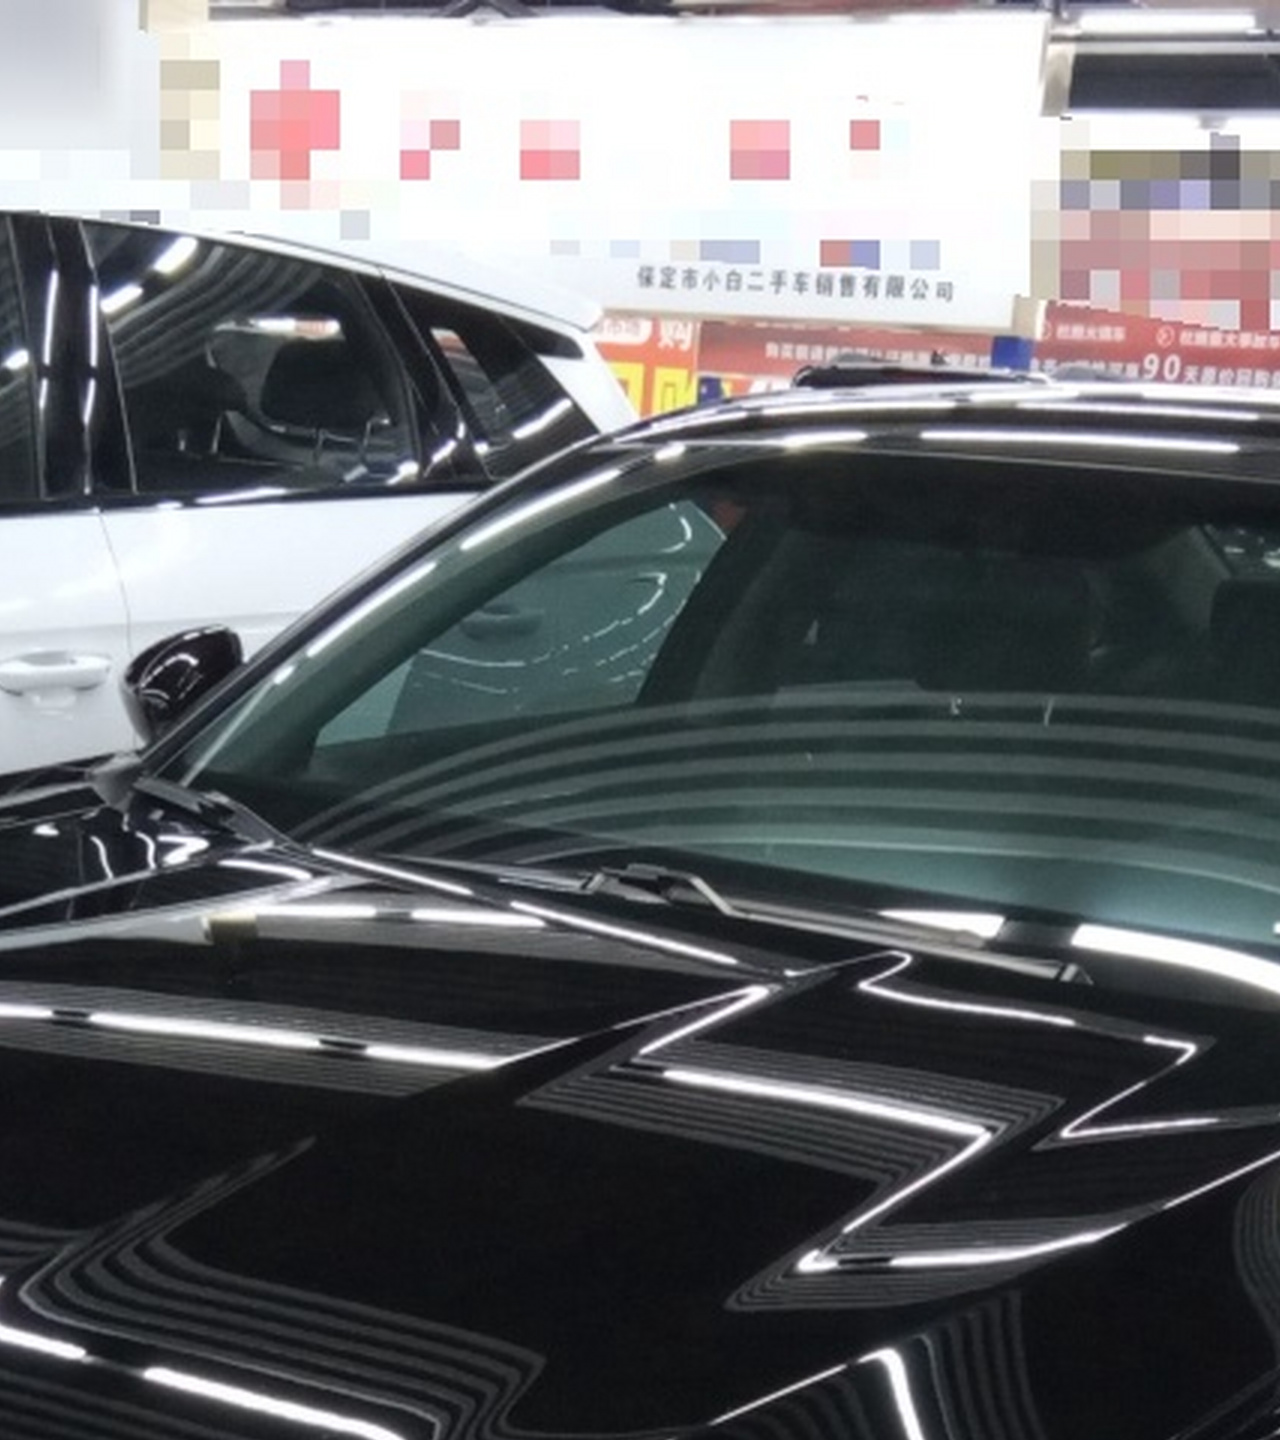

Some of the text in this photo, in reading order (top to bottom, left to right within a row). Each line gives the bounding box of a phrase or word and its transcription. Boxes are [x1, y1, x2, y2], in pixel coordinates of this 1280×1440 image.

[637, 265, 955, 303] 保定市小白二手车销售有限公司
